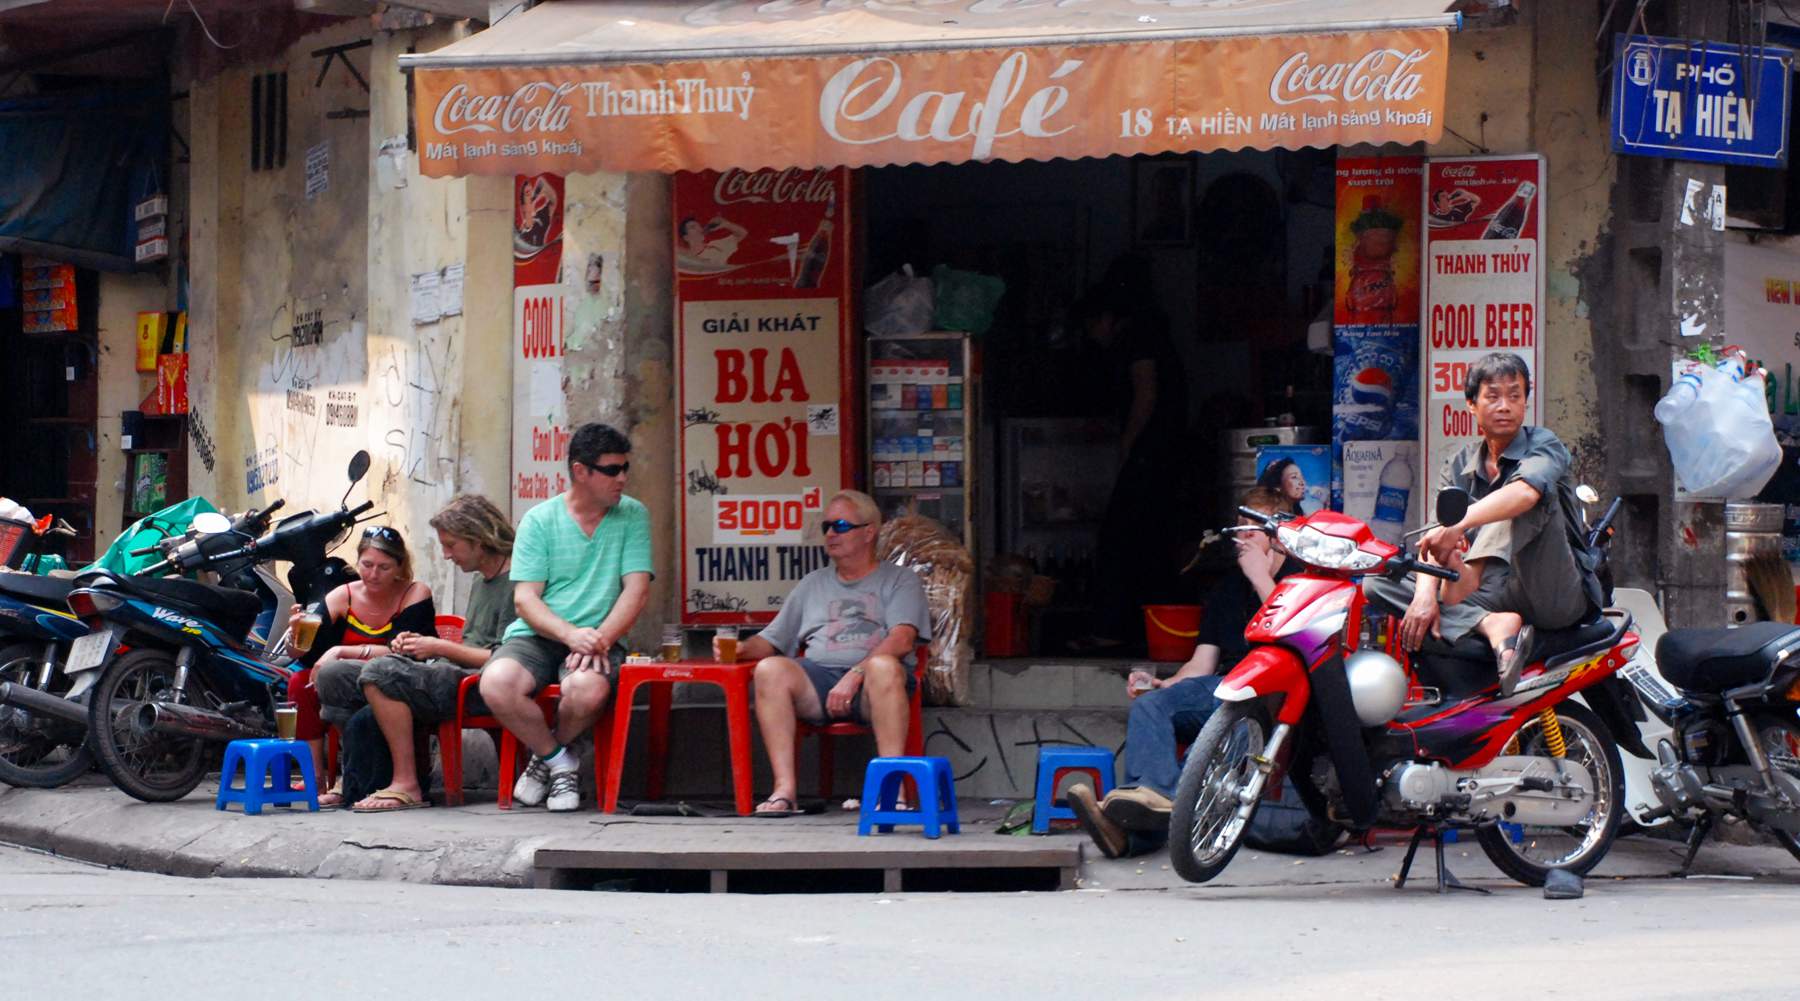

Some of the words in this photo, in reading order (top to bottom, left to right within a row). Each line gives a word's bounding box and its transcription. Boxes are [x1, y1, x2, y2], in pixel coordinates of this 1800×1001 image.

[1270, 48, 1432, 105] Coca-Cola
[1676, 63, 1735, 86] PHỐ
[434, 81, 579, 135] Coca-Cola
[819, 51, 1084, 159] Café
[1119, 108, 1153, 137] 18
[1260, 112, 1296, 131] Mát
[1653, 90, 1682, 140] TẠ
[1696, 90, 1754, 145] HIỆN
[426, 142, 458, 160] Mát
[714, 166, 835, 205] Coca-Cola
[1435, 254, 1486, 274] THANH
[1492, 245, 1531, 273] THỦY
[523, 296, 555, 359] COOL
[702, 312, 749, 334] GIẢI
[758, 313, 821, 333] KHÁT
[1431, 304, 1479, 349] COOL
[1485, 303, 1533, 348] BEER
[714, 347, 810, 404] BIA
[1434, 362, 1467, 392] 30
[1443, 404, 1472, 437] Cool
[533, 426, 551, 462] Cool
[715, 416, 812, 479] HƠI
[695, 546, 770, 581] THANH
[152, 606, 203, 628] Wave
